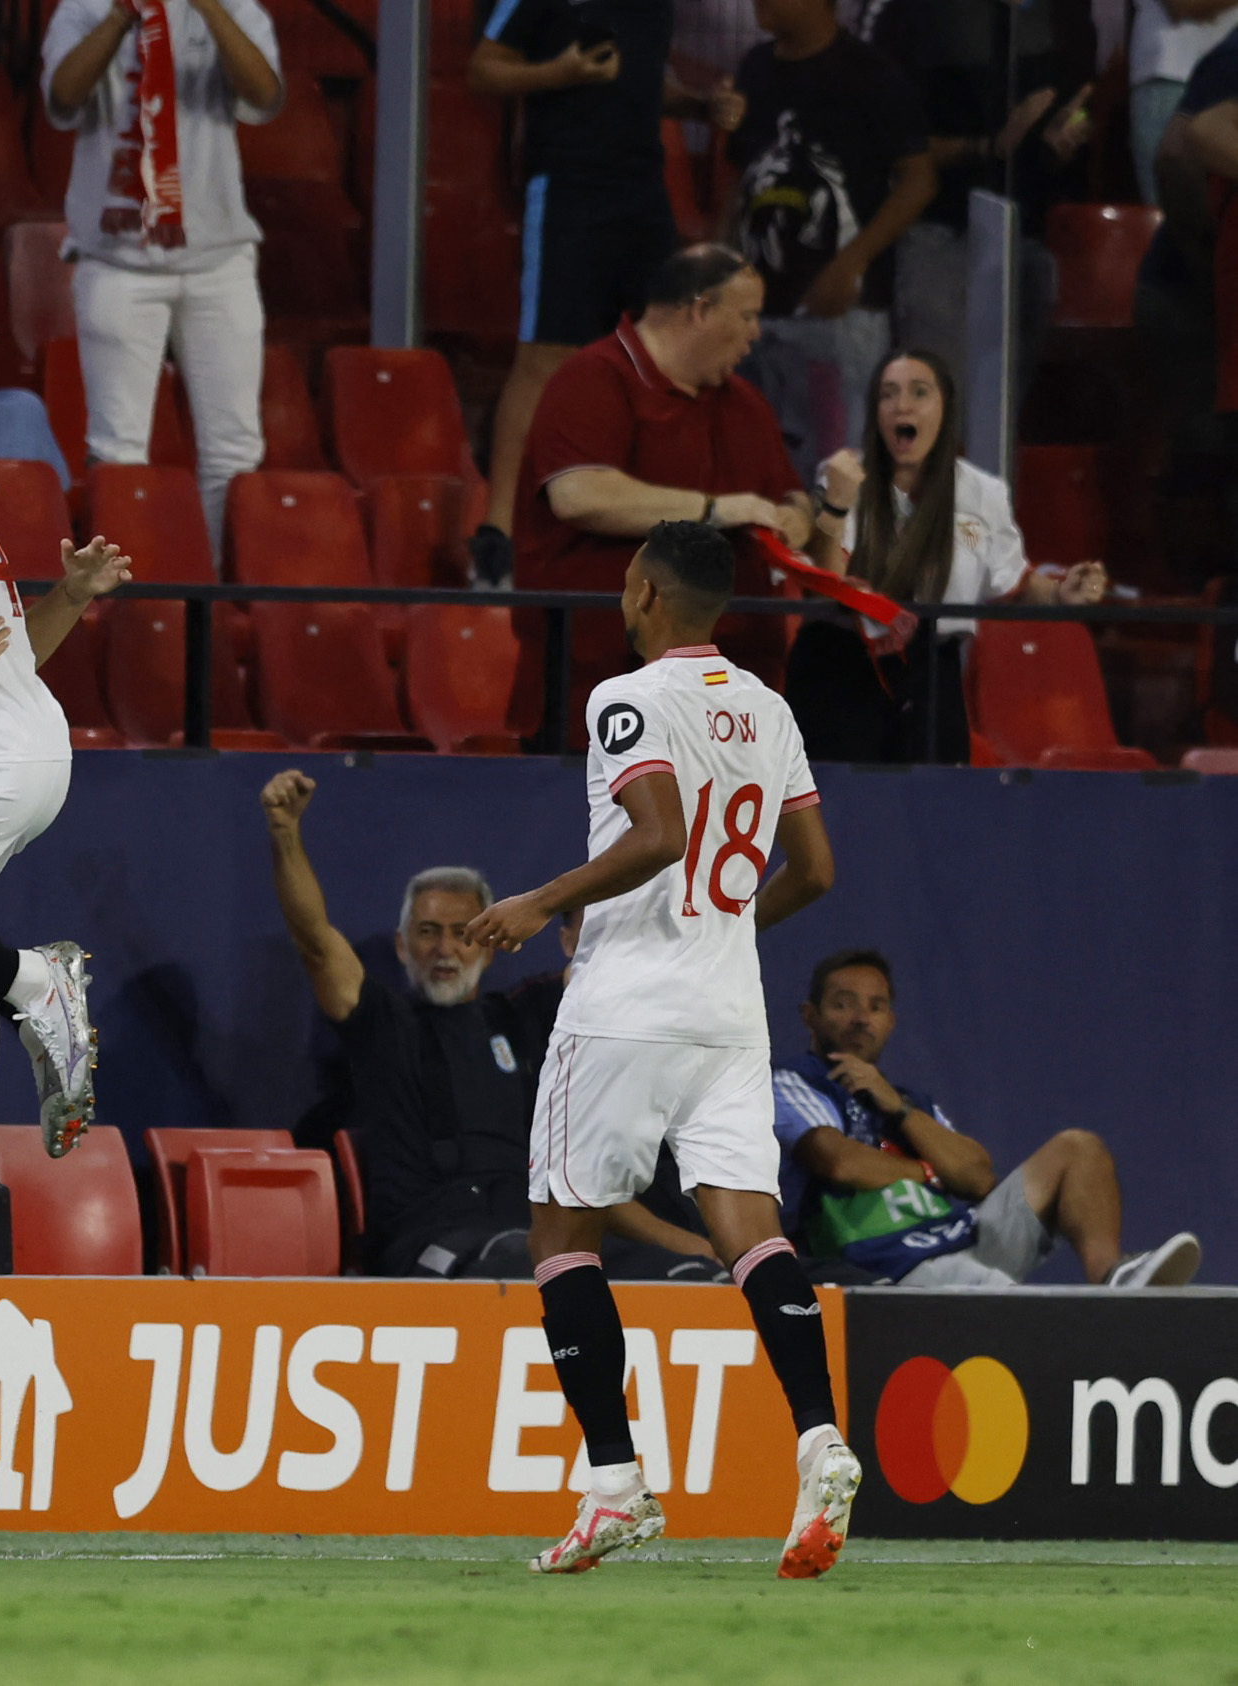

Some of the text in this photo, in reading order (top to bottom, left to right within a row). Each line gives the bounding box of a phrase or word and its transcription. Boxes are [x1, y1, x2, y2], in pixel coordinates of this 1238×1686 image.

[604, 711, 638, 749] JD
[706, 710, 756, 743] SOW
[681, 777, 767, 917] 18
[113, 1322, 758, 1520] JUST EAT
